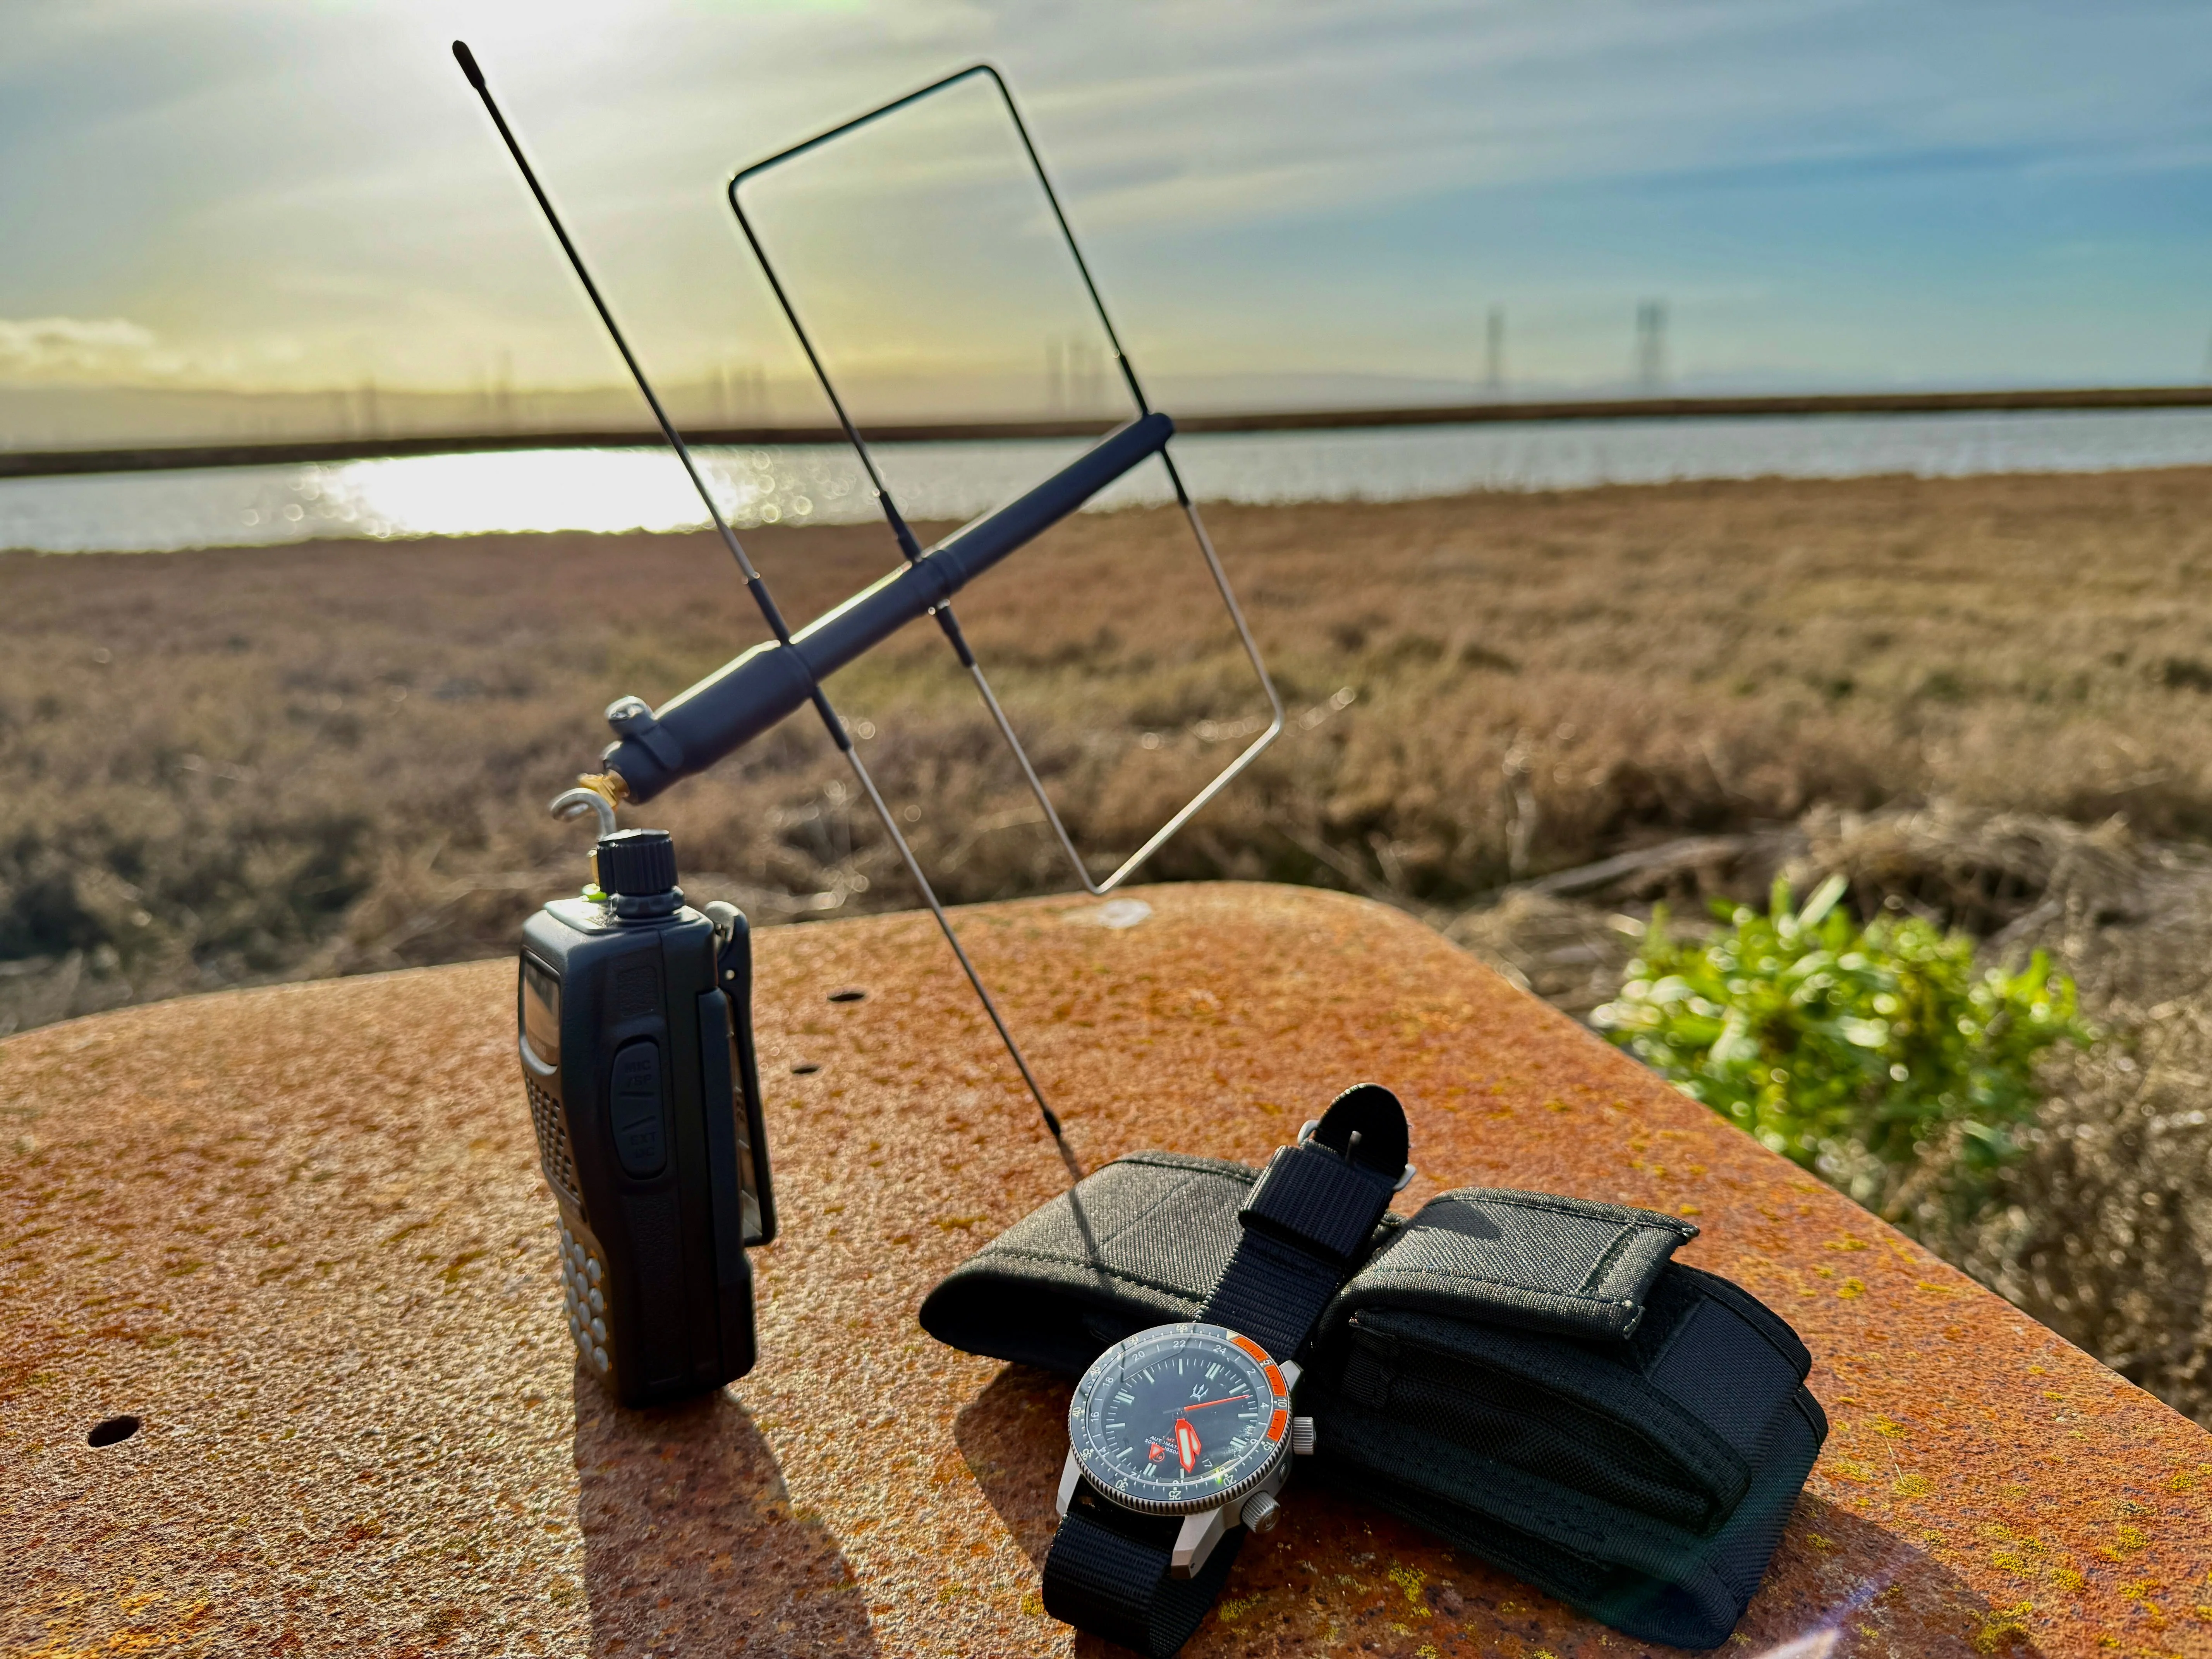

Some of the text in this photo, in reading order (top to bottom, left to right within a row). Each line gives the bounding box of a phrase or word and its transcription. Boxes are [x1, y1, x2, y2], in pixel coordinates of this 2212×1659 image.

[624, 1060, 651, 1073] MIC
[630, 1132, 656, 1145] EXT
[635, 1147, 655, 1158] DC
[1213, 1345, 1227, 1354] 24
[1132, 1351, 1145, 1362] 20
[1090, 1366, 1101, 1376] 45
[1103, 1377, 1114, 1387] 18
[1278, 1398, 1287, 1407] 10
[1073, 1407, 1082, 1418] 40
[1091, 1411, 1099, 1422] 16
[1150, 1436, 1178, 1450] AUTOMAT
[1263, 1441, 1275, 1452] 15
[1080, 1448, 1092, 1460] 35
[1202, 1458, 1213, 1468] 17
[1115, 1479, 1128, 1491] 30
[1223, 1474, 1236, 1486] 20
[1168, 1490, 1181, 1500] 25
